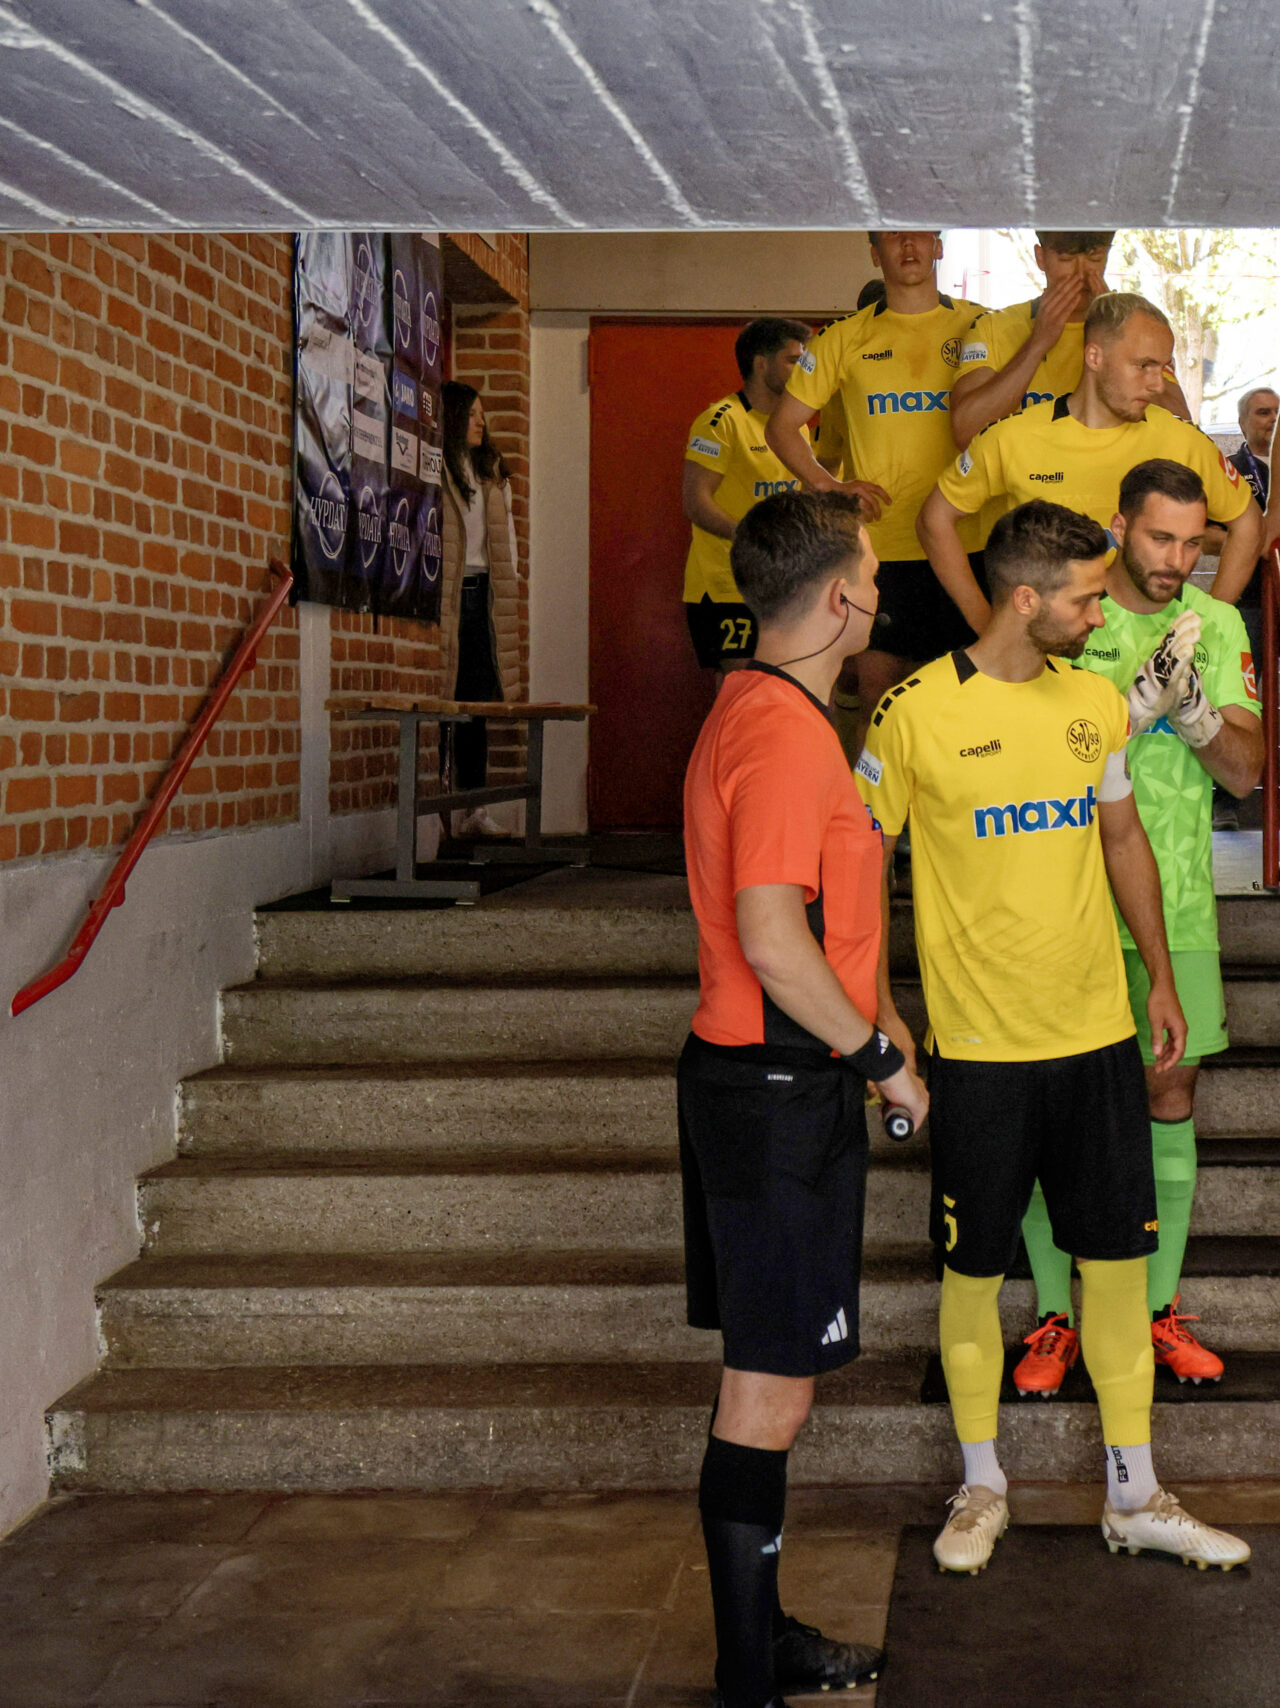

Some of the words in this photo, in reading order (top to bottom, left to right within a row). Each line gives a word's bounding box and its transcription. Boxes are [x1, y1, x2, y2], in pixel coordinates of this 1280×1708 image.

[862, 349, 893, 361] capelli
[866, 389, 952, 416] max
[1029, 472, 1064, 483] capelli
[720, 618, 752, 650] 27
[1085, 648, 1121, 660] capelli
[960, 739, 1002, 758] capelli
[974, 785, 1097, 839] maxit
